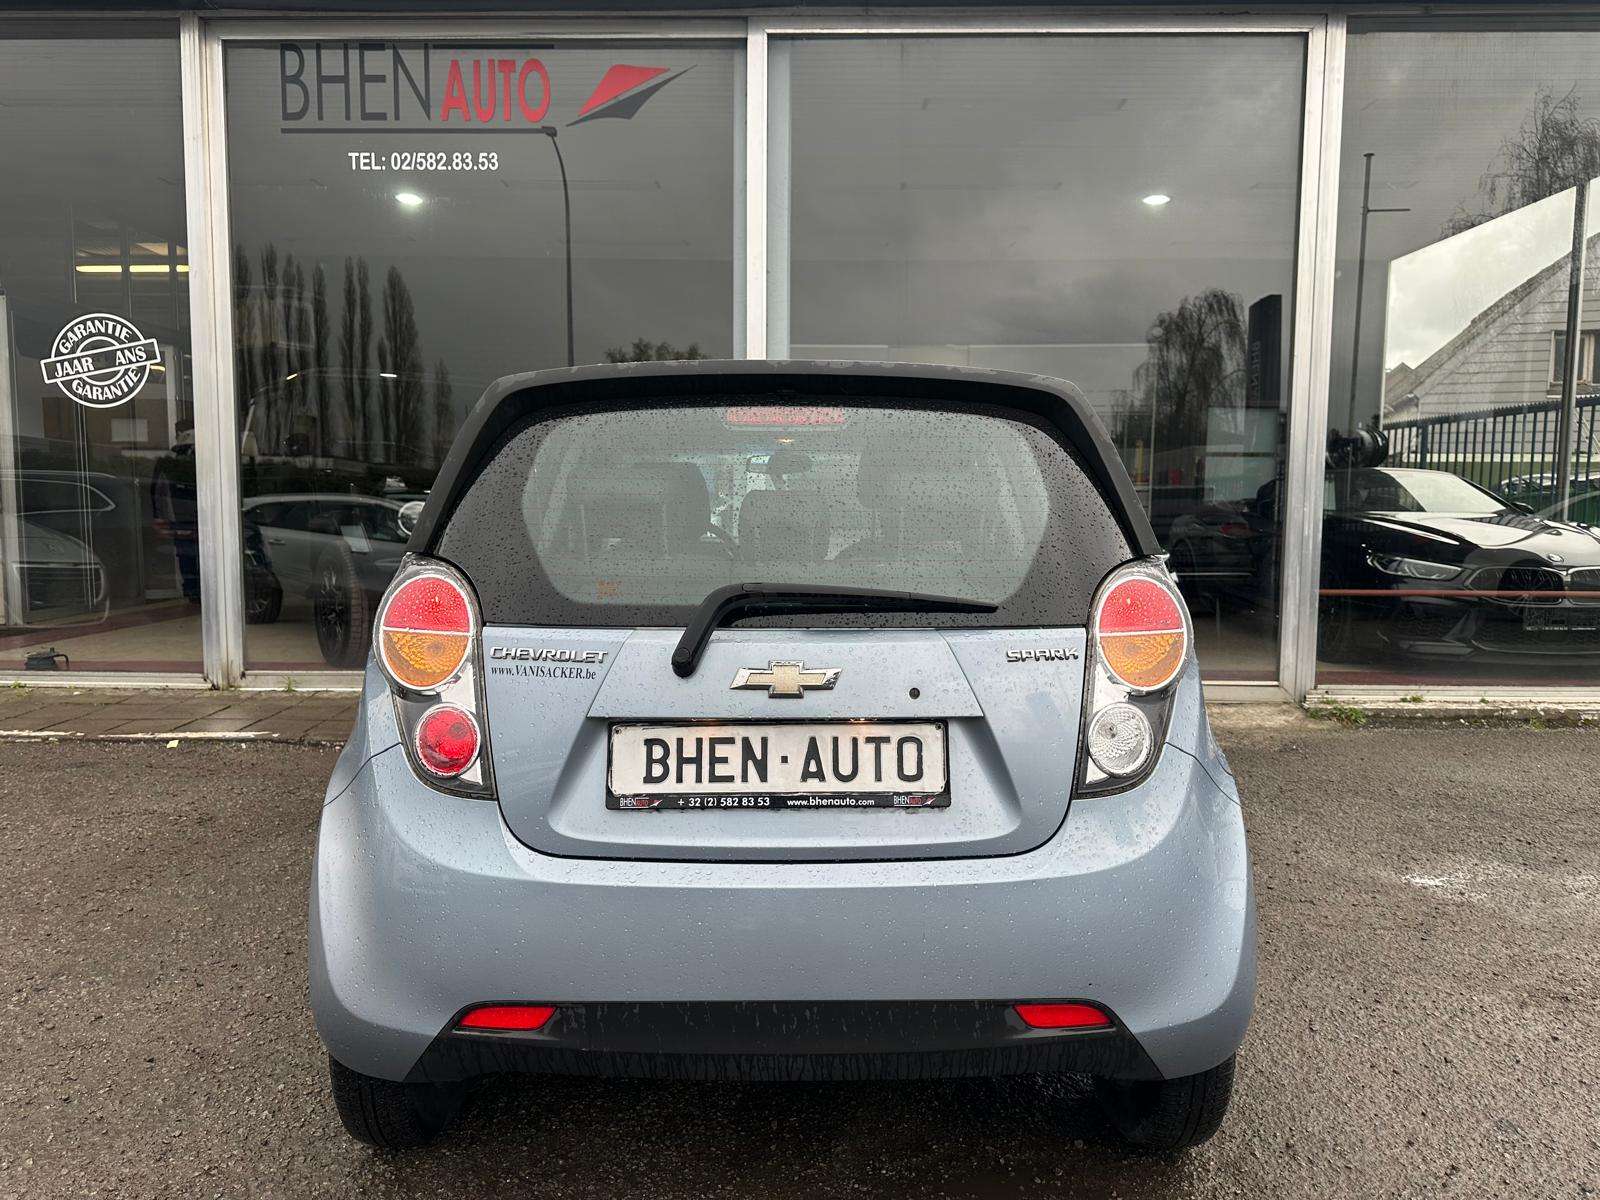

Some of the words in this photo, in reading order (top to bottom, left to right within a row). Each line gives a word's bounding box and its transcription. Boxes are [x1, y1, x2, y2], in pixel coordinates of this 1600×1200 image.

[280, 43, 431, 121] BHEN
[440, 58, 551, 123] AUTO
[348, 152, 386, 171] TEL:
[391, 152, 499, 171] 02/582.83.53
[59, 320, 132, 354] GARANTIE
[55, 357, 95, 378] JAAR
[115, 346, 147, 366] ANS
[71, 366, 141, 401] GARANTIE
[490, 646, 608, 664] CHEVROLET
[1007, 647, 1079, 663] SPARK
[491, 665, 597, 680] www.VANISACKER.be
[688, 797, 701, 807] 32
[704, 796, 717, 807] (2)
[720, 796, 739, 806] 582
[741, 796, 755, 806] 83
[757, 796, 770, 806] 53
[787, 796, 875, 807] www.bhenauto.com
